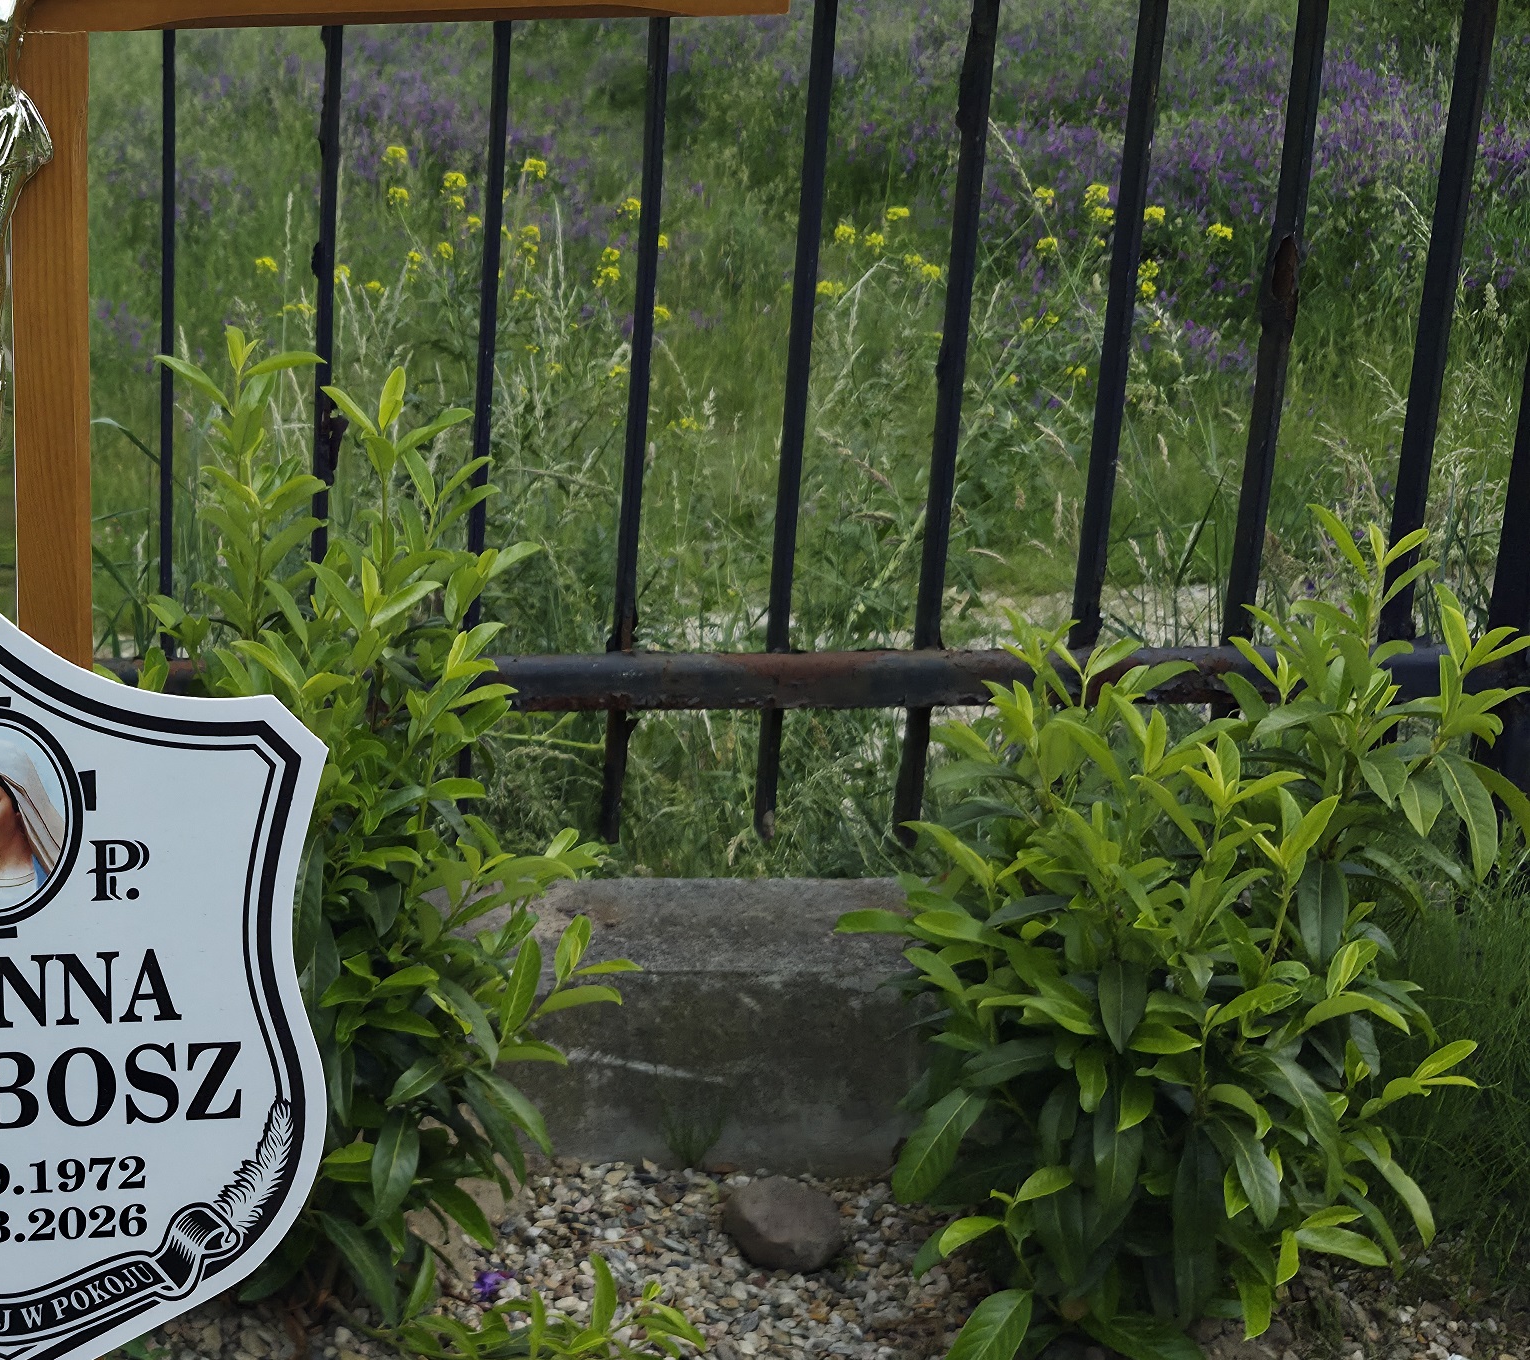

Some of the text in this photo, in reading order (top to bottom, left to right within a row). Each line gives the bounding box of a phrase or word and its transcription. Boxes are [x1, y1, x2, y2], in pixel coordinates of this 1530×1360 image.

[86, 838, 150, 902] P.
[20, 1302, 43, 1328] W
[50, 1263, 154, 1321] POKOJU
